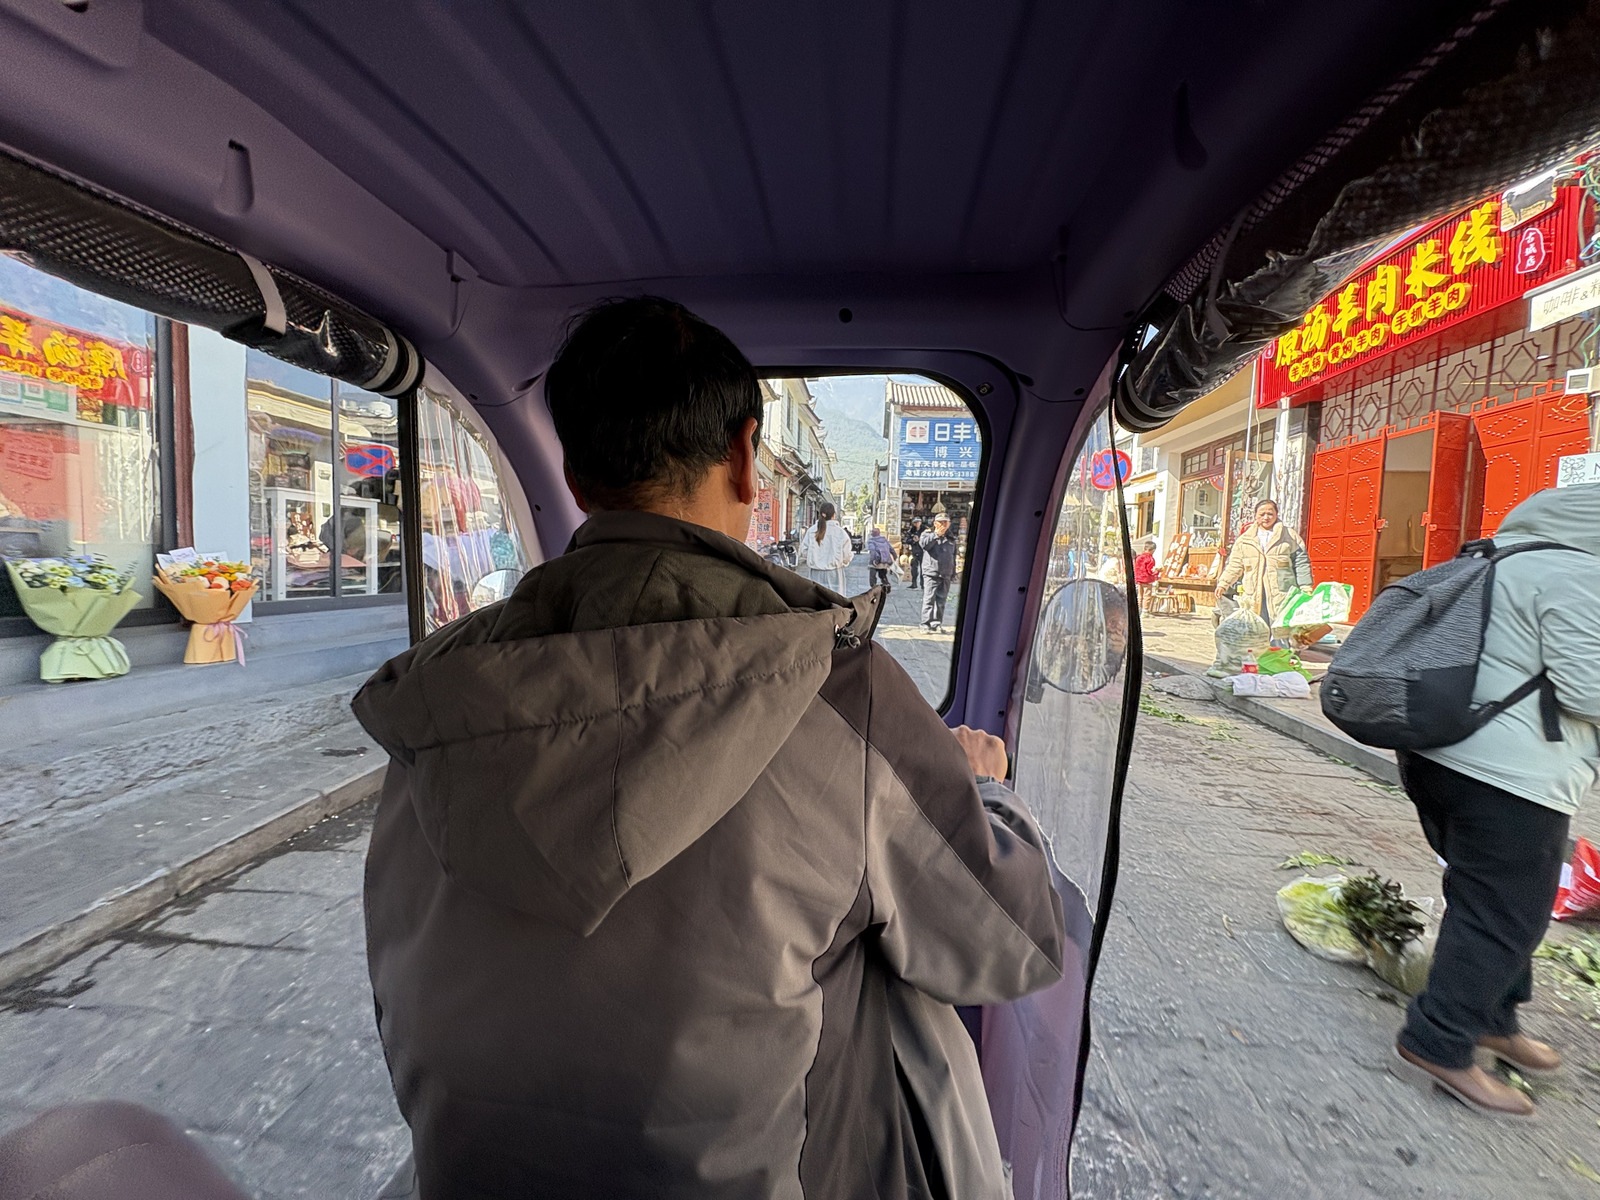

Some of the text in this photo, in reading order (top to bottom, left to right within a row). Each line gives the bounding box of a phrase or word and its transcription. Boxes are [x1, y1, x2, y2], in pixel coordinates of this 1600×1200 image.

[1275, 202, 1500, 370] 原汤羊肉米线
[1393, 285, 1465, 333] 手抓羊肉
